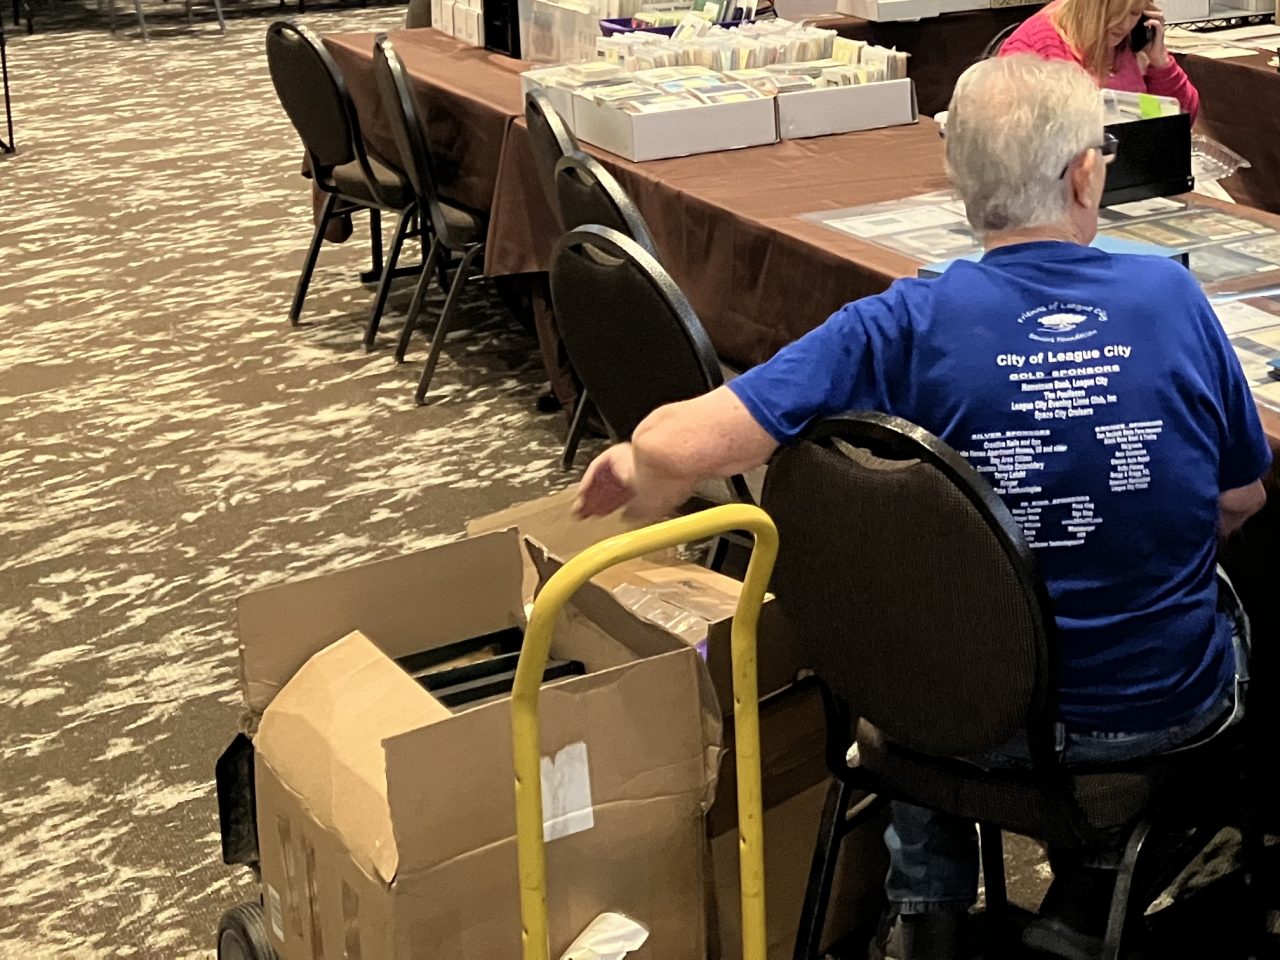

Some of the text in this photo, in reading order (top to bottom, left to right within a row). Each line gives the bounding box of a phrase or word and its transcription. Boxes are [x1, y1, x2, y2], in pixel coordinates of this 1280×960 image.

[996, 345, 1131, 367] City of League City
[1009, 364, 1120, 381] GOLD SPONSORS
